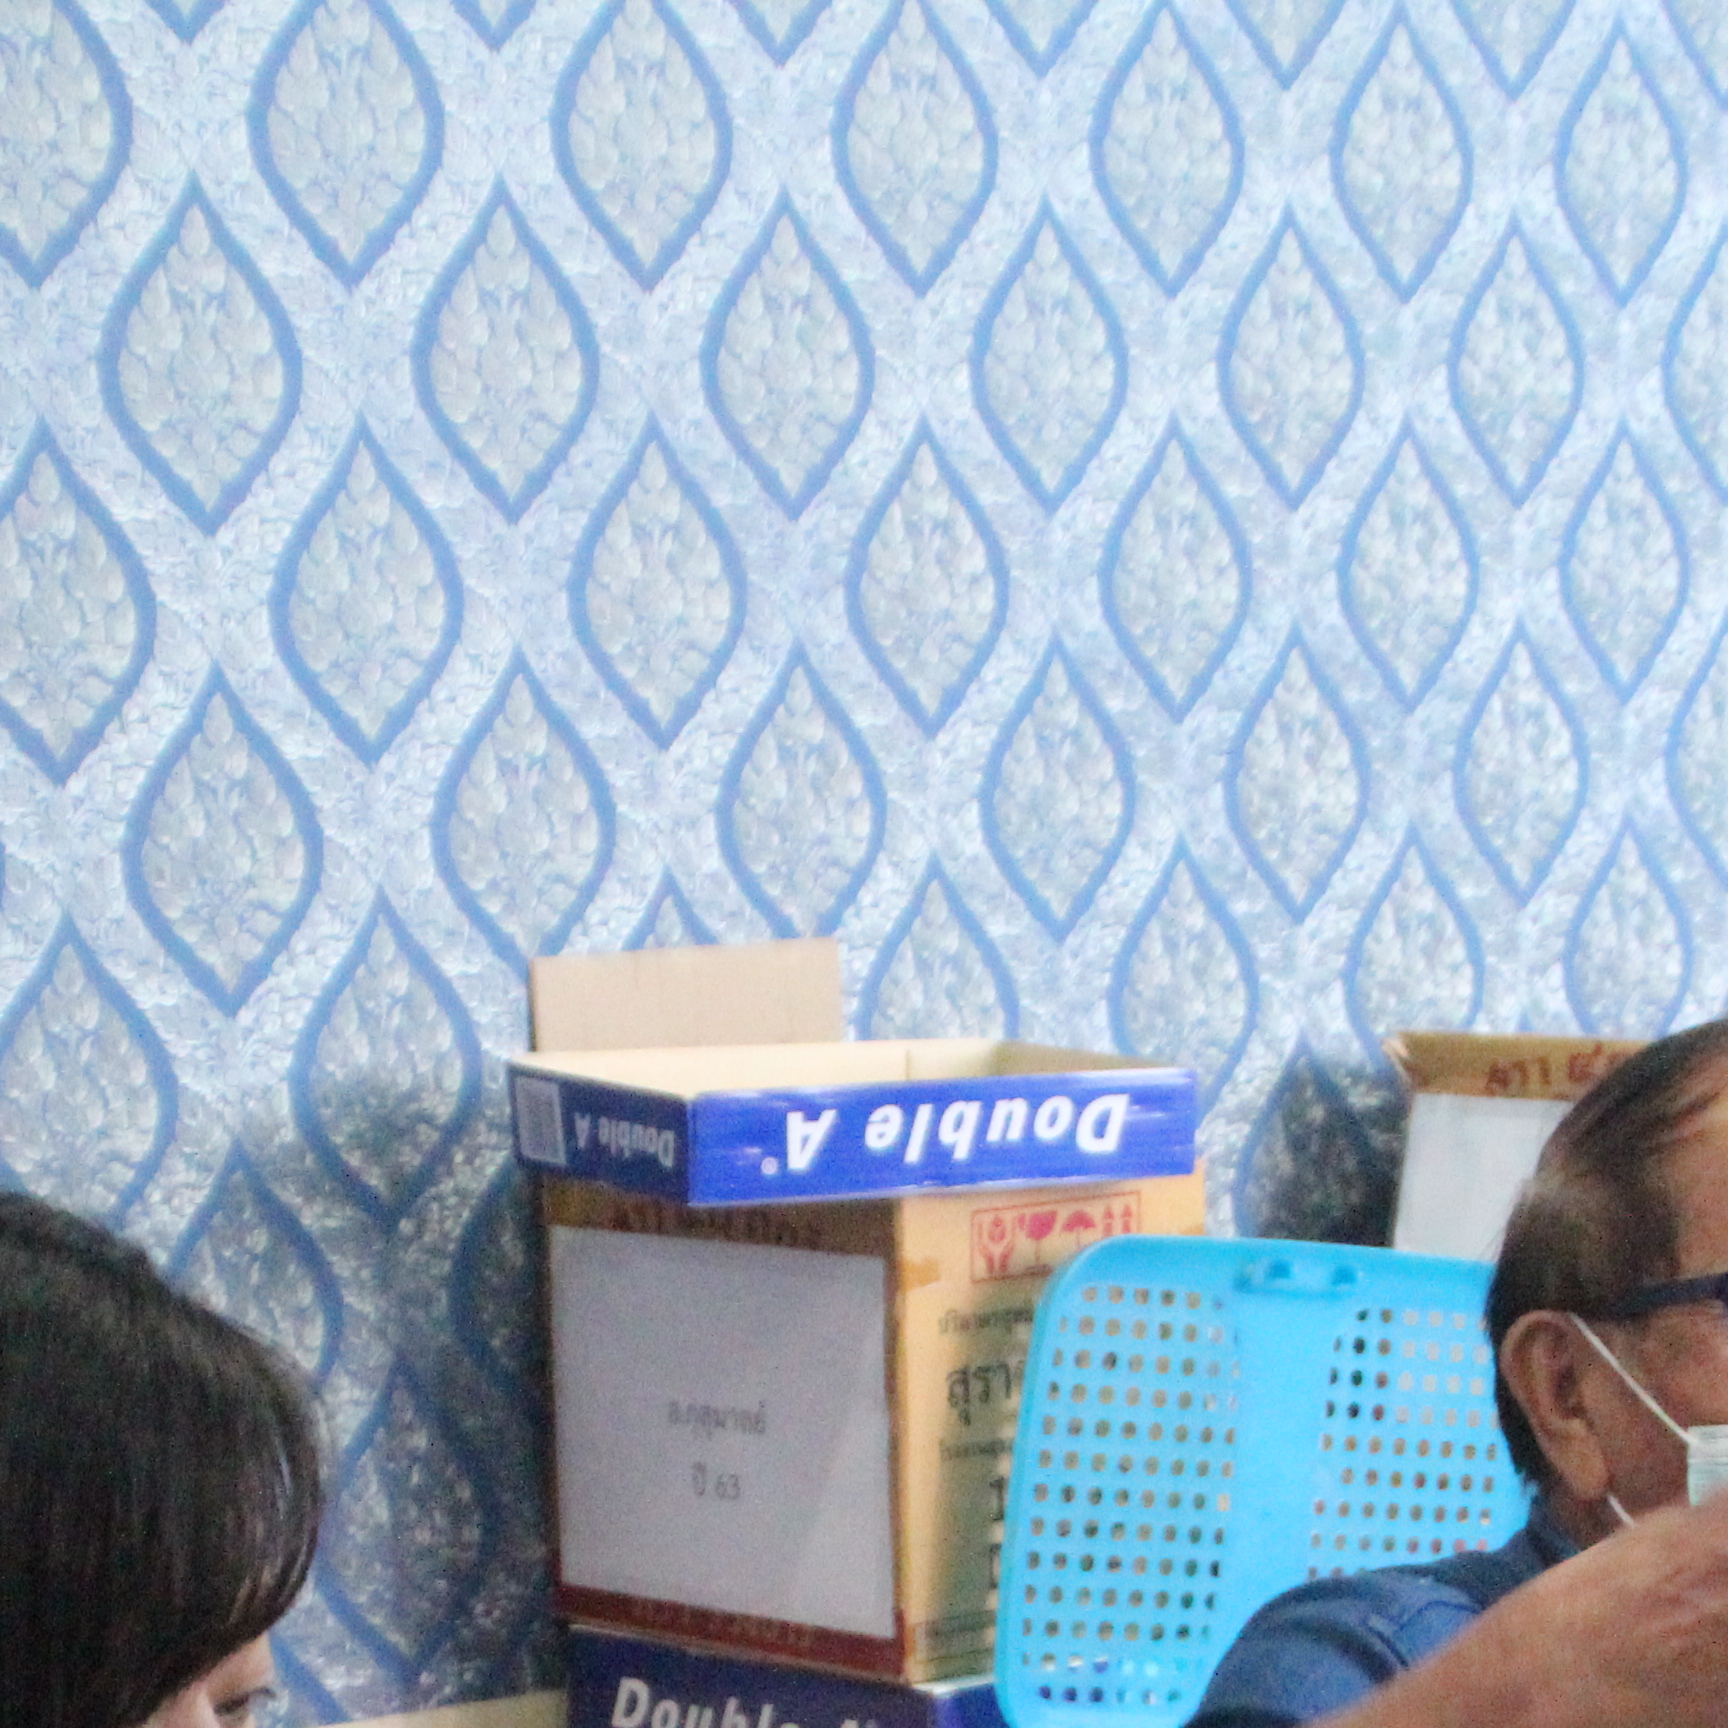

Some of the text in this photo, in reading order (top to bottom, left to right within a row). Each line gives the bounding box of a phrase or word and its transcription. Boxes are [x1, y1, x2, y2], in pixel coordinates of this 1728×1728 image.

[574, 1113, 675, 1168] Double A
[786, 1093, 1130, 1173] Double A
[714, 1472, 741, 1501] 63
